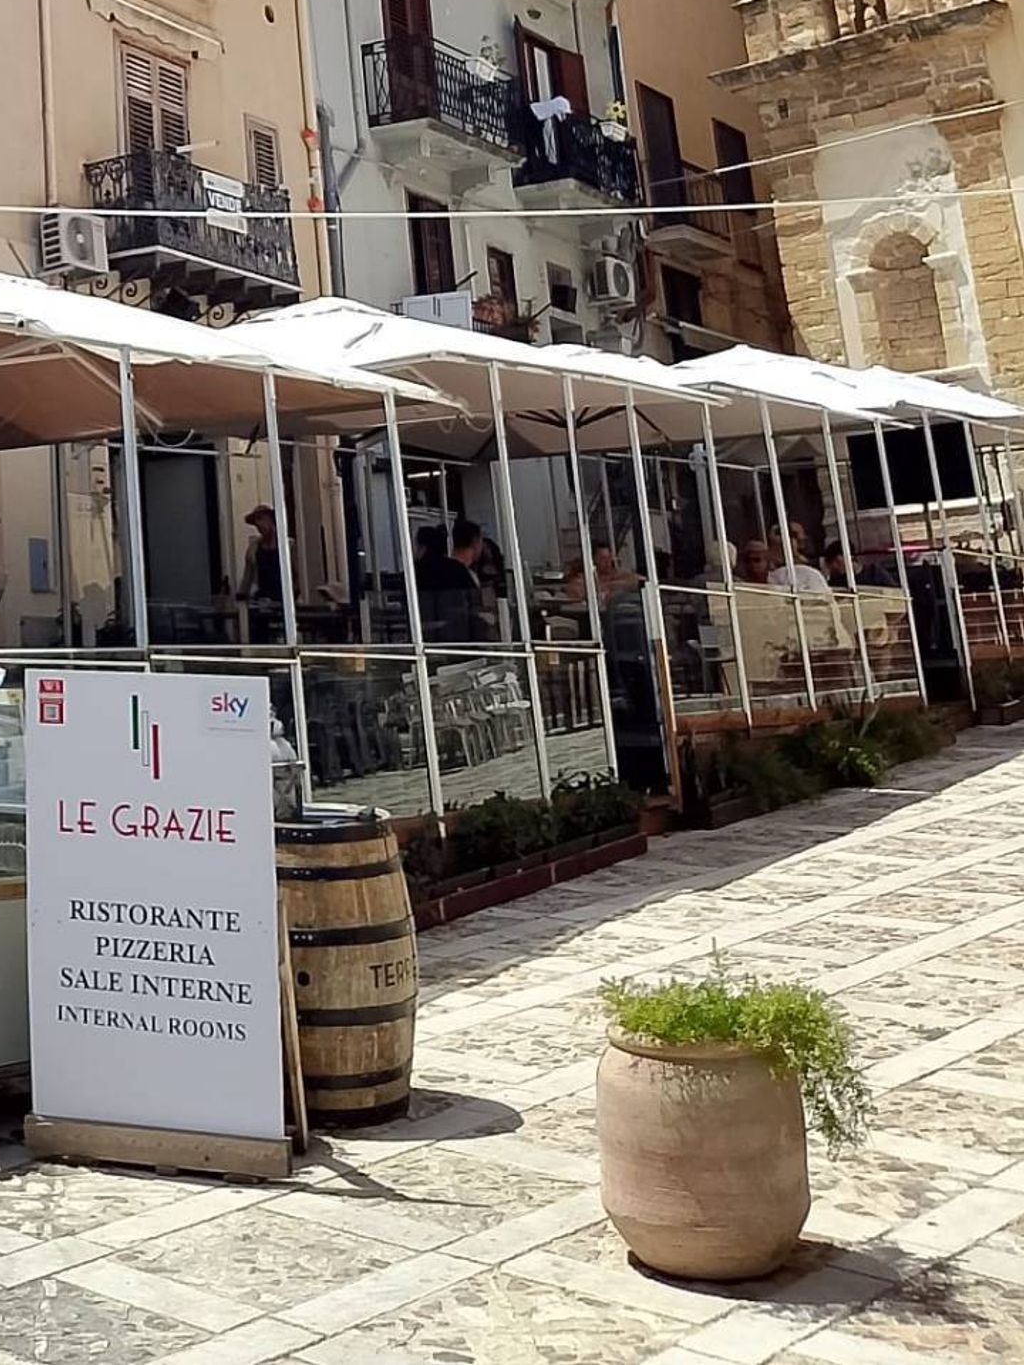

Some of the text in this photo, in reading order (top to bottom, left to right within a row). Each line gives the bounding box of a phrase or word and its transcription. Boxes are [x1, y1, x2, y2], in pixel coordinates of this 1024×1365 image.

[211, 692, 248, 717] sky
[59, 800, 236, 843] LE GRAZIE
[69, 899, 241, 933] RISTORANTE
[95, 936, 216, 966] PIZZERIA
[60, 967, 253, 1005] SALE INTERNE
[57, 1004, 247, 1042] INTERNAL ROOMS
